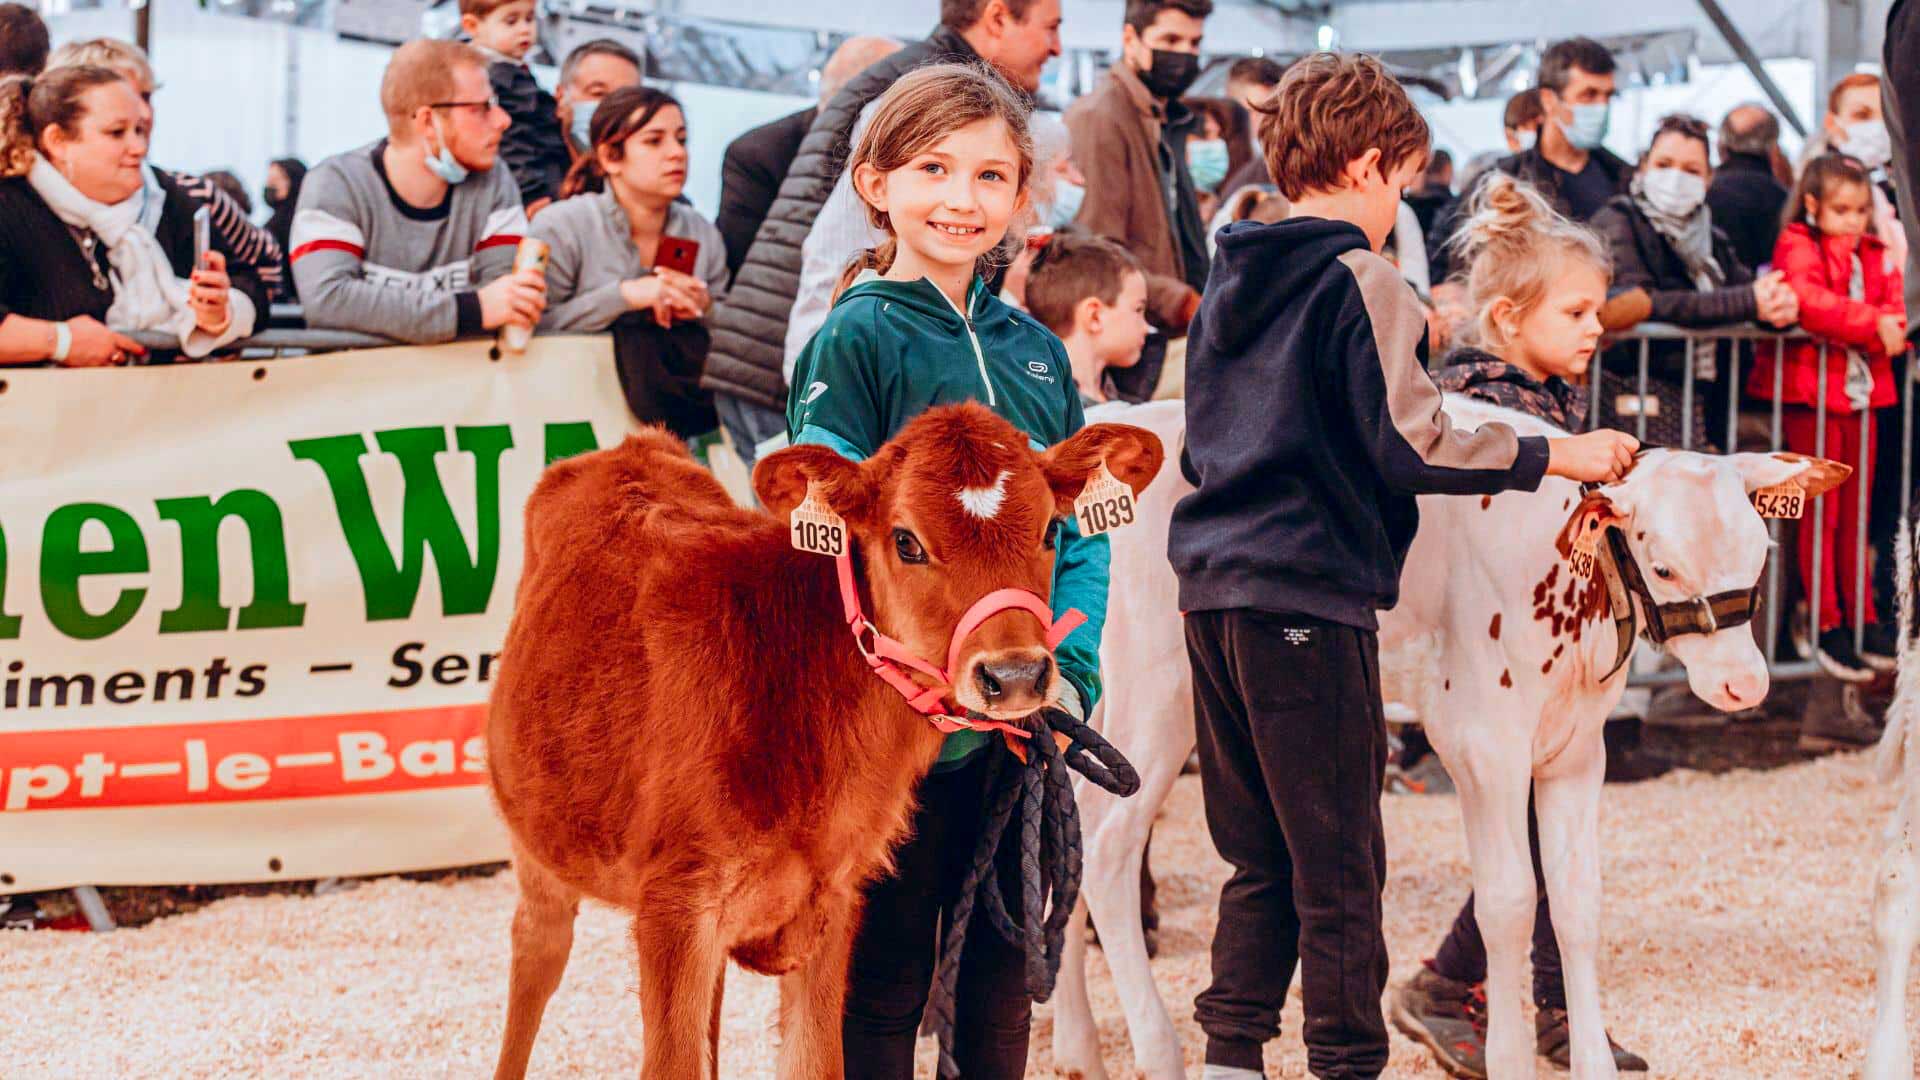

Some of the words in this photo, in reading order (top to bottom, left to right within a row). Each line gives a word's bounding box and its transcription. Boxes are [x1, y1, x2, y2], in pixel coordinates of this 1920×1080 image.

[1080, 495, 1134, 534] 1039
[1757, 494, 1800, 517] 5438
[795, 520, 842, 555] 1039
[1568, 548, 1593, 578] 5438
